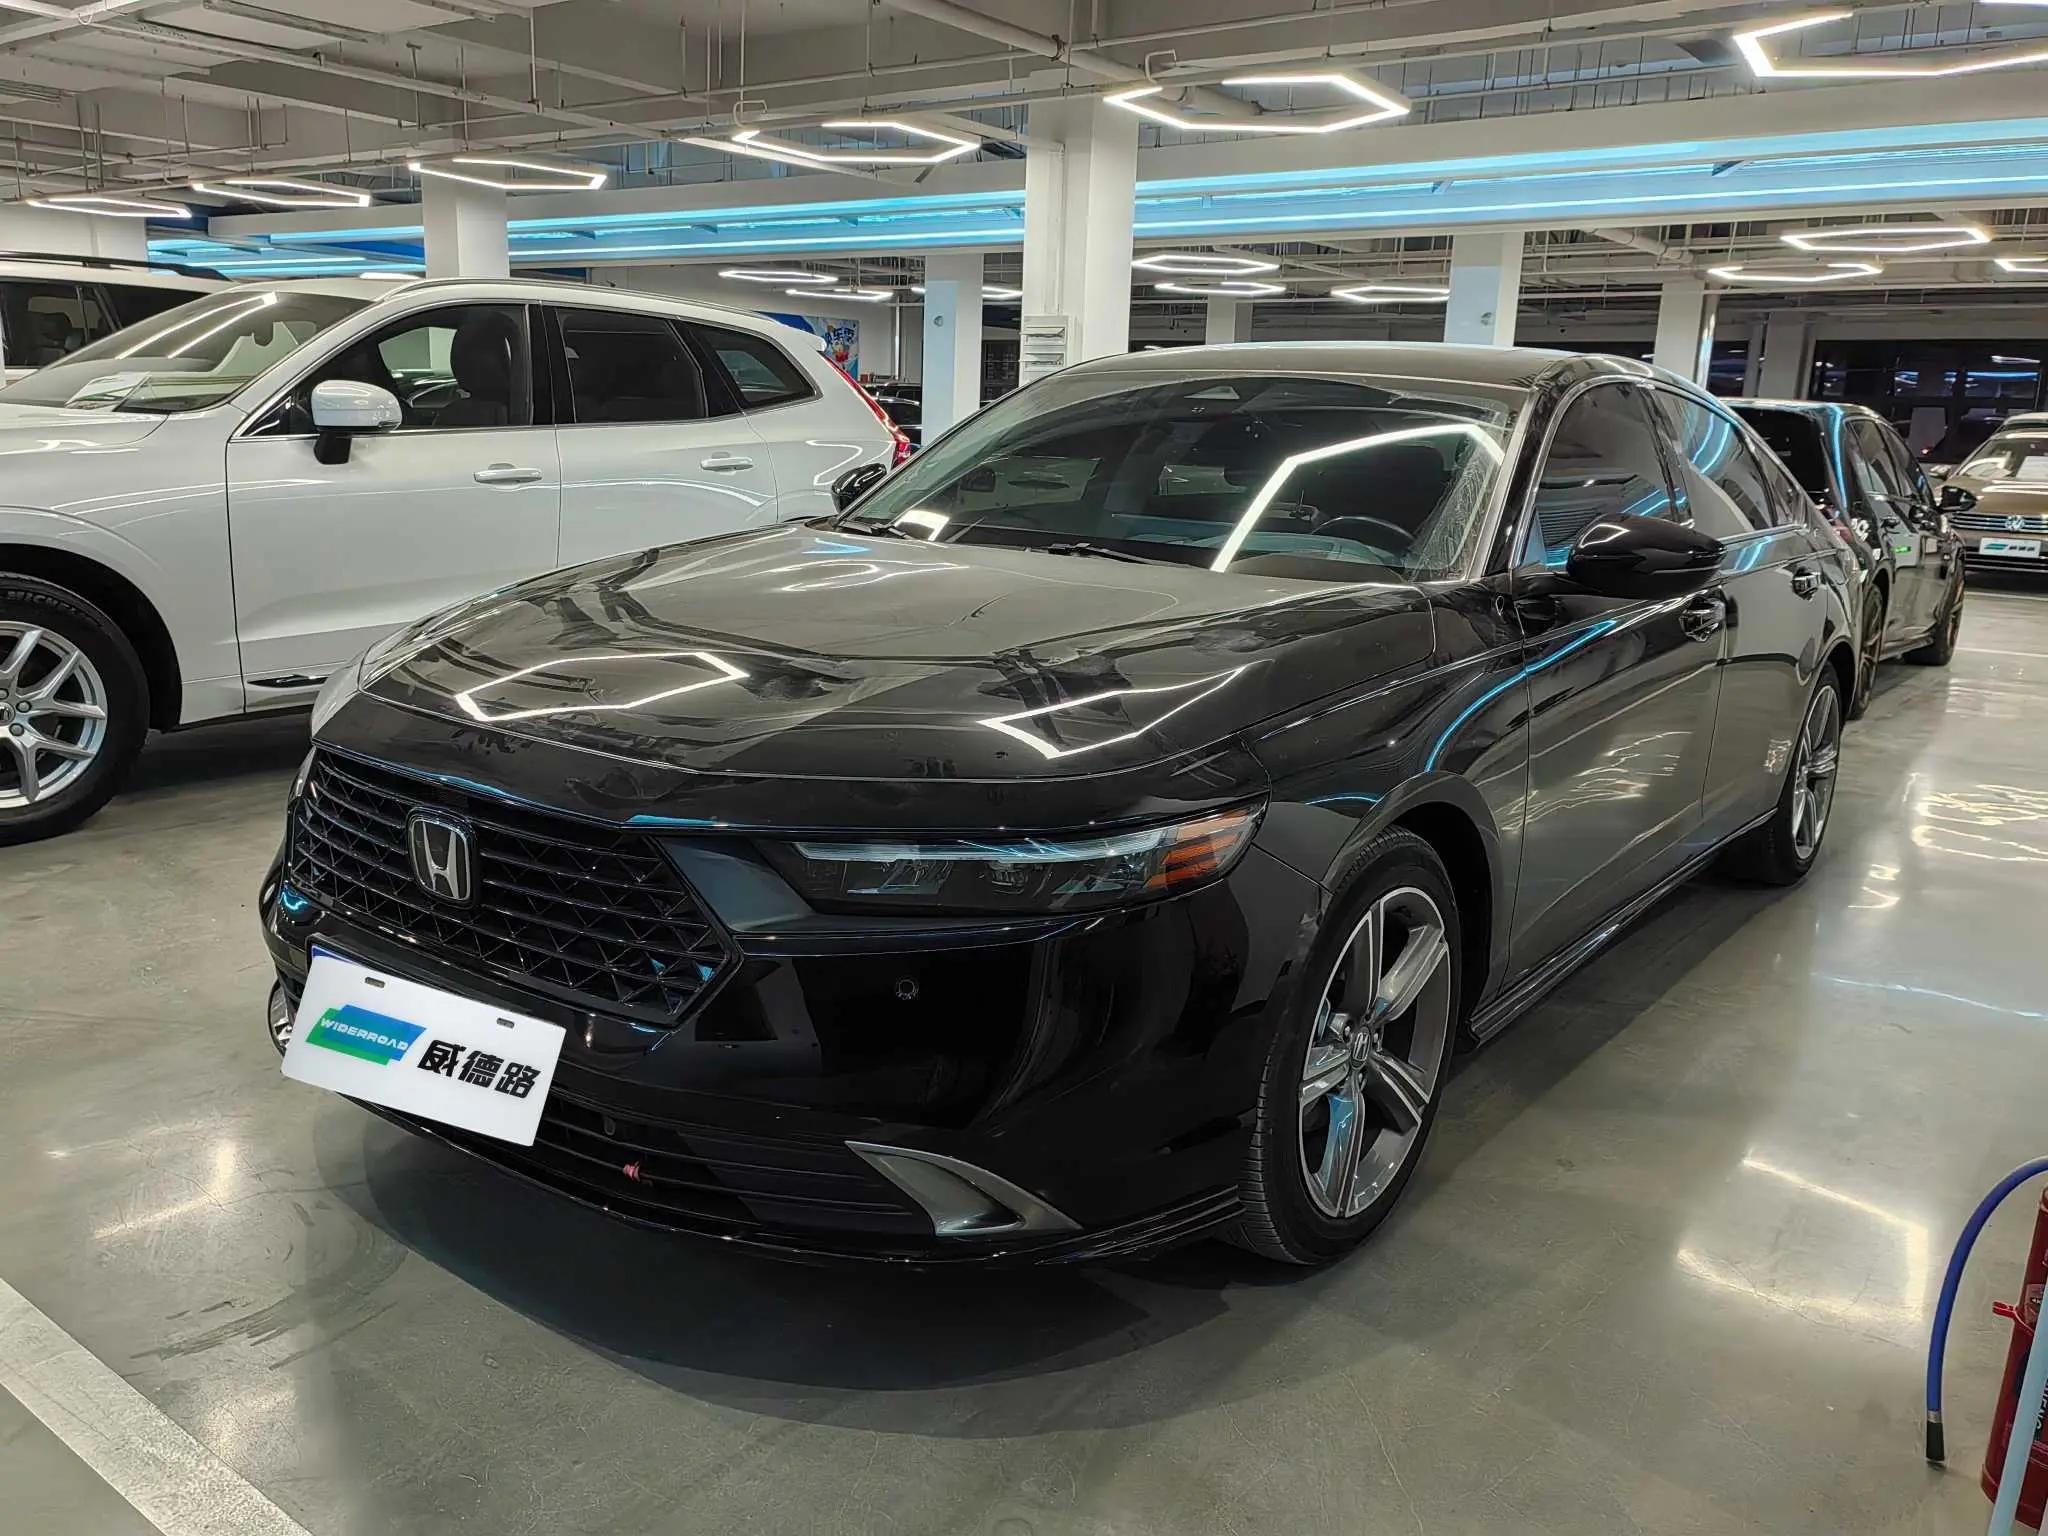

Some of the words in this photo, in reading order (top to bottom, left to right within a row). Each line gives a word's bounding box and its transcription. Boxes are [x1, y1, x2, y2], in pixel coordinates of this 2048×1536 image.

[320, 1018, 409, 1051] WIDERROAD
[417, 1039, 541, 1099] 威德路
